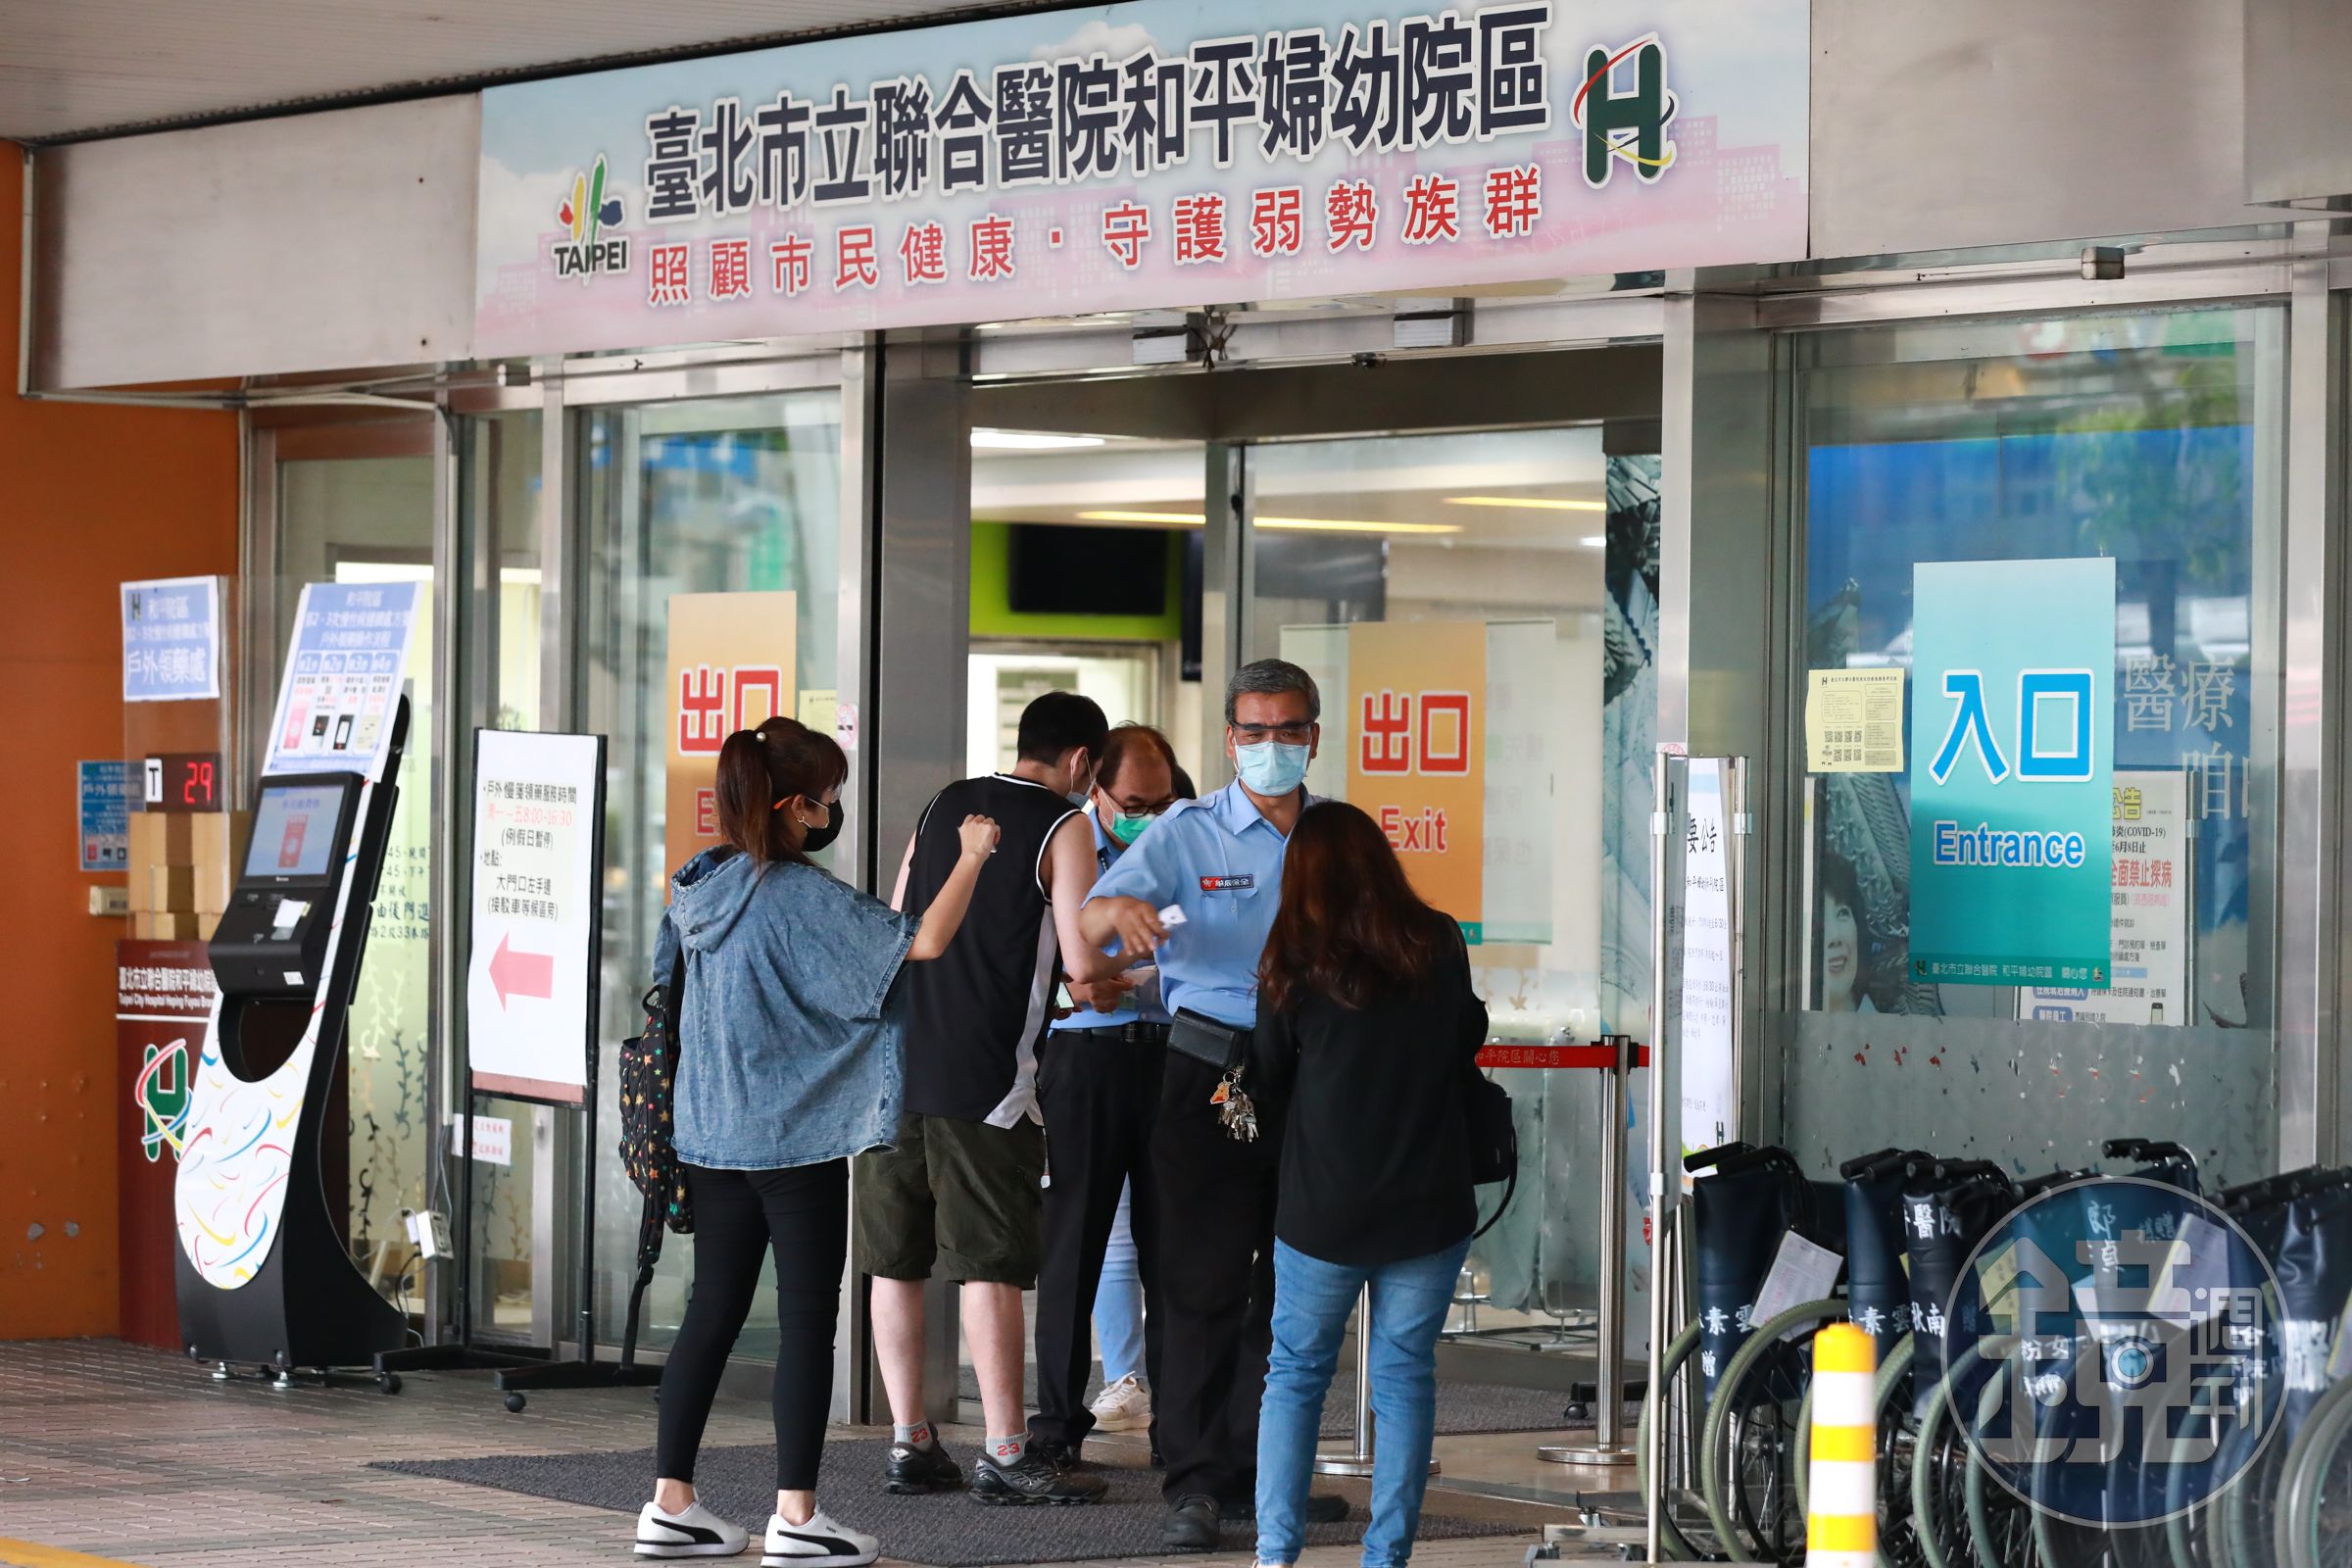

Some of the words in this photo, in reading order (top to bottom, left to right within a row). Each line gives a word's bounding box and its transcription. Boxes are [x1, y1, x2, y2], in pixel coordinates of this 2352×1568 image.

[647, 8, 1548, 220] 臺北市立聯合醫院和平婦幼院區
[554, 239, 627, 275] TAIPEI
[2124, 654, 2235, 732] 醫療
[1361, 692, 1469, 775] 出口
[1931, 670, 2093, 783] 入口
[184, 761, 214, 804] 29
[1381, 807, 1448, 852] Exit
[1935, 821, 2084, 866] Entrance
[2113, 825, 2167, 839] 炎(COVID-19)
[2113, 841, 2147, 855] 6月8日止
[1932, 962, 1998, 977] 臺北市立聯合醫院
[2002, 964, 2052, 979] 和平婦幼院區
[2061, 966, 2088, 980] 關心您
[1698, 1303, 1754, 1336] 素雲
[1848, 1302, 1910, 1336] 素雲
[910, 1427, 929, 1444] 23
[997, 1442, 1020, 1456] 23
